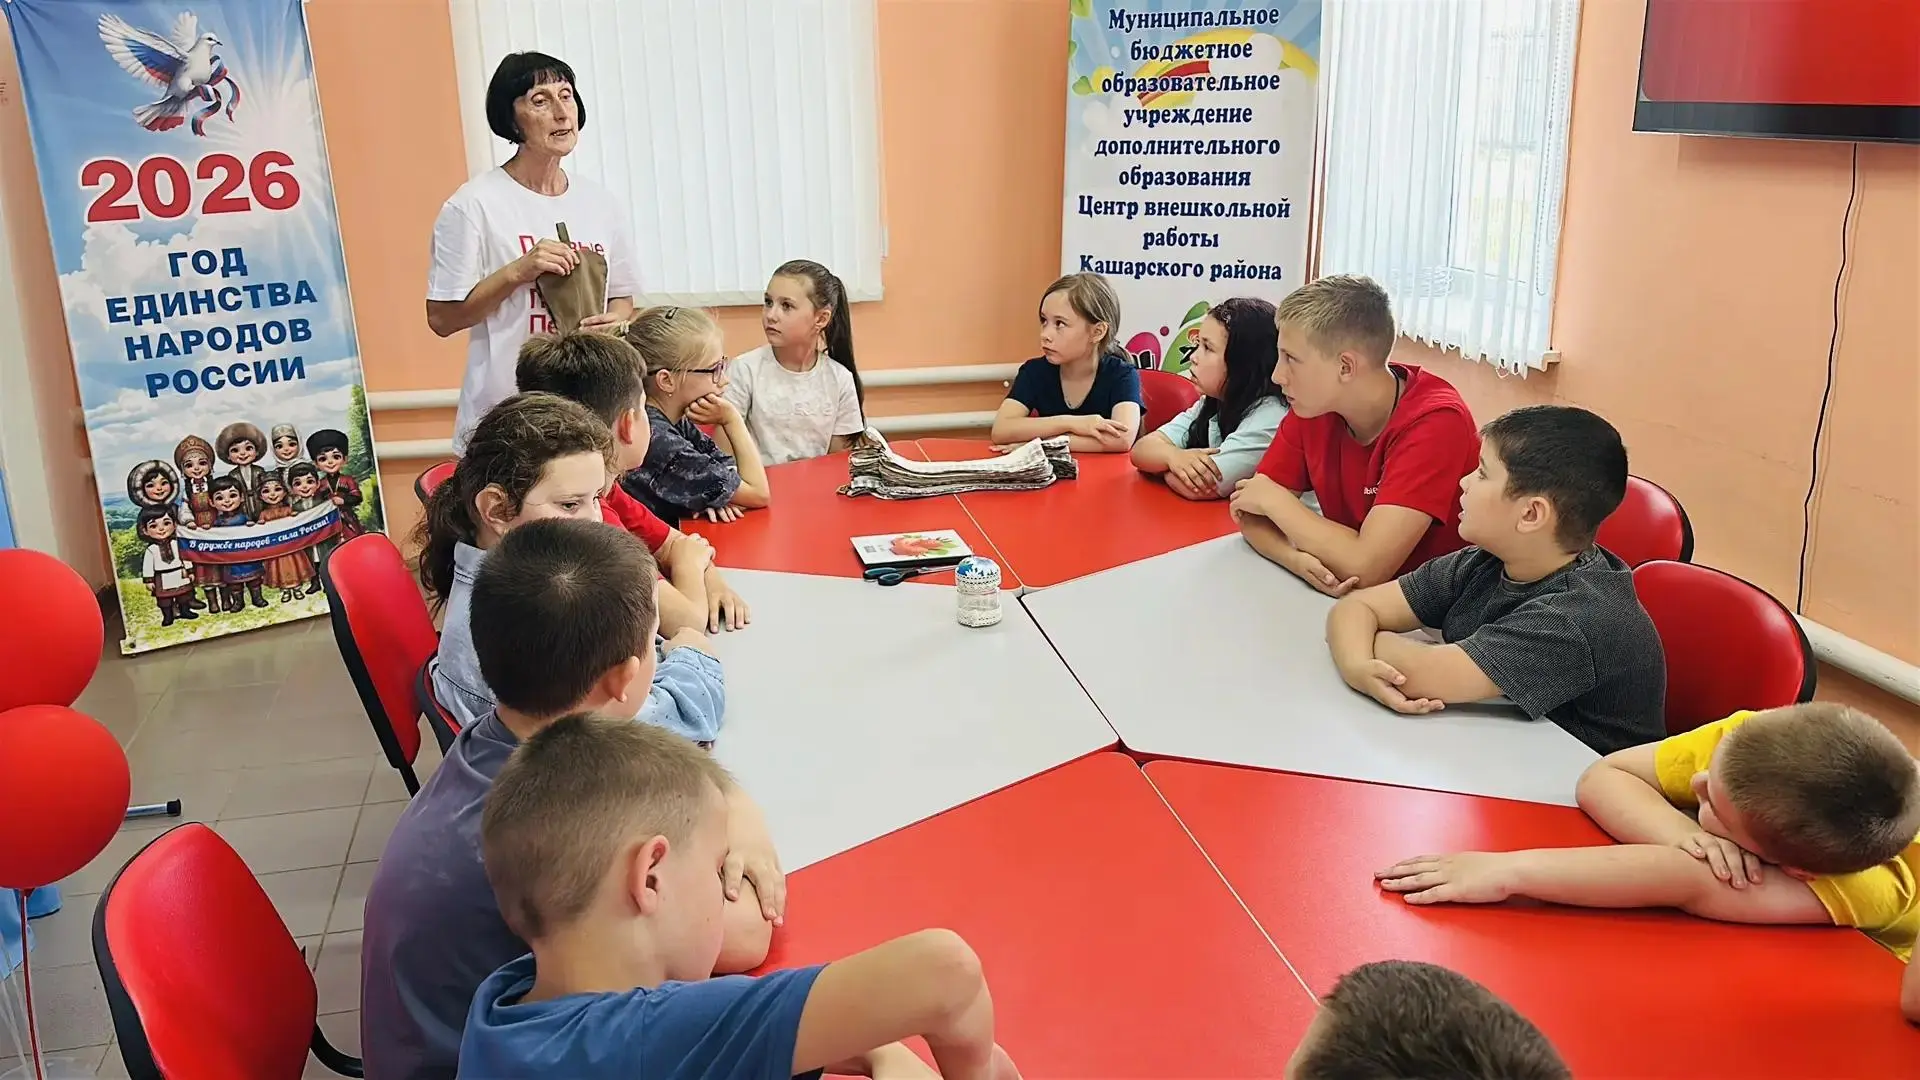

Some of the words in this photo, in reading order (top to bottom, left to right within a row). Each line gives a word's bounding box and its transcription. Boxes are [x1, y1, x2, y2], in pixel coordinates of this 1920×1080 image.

[1109, 9, 1279, 32] Муниципальное
[1131, 40, 1253, 62] бюджетное
[1102, 72, 1280, 96] образовательное
[1124, 107, 1253, 128] учреждение
[1095, 139, 1280, 156] дополнительного
[81, 151, 301, 222] 2026
[1119, 165, 1251, 189] образования
[1079, 195, 1138, 219] Центр
[1144, 198, 1290, 218] внешкольной
[1143, 227, 1219, 249] работы
[168, 247, 248, 278] ГОД
[1080, 255, 1204, 279] Кашарского
[1210, 260, 1282, 281] района
[106, 279, 317, 325] ЕДИНСТВА
[124, 318, 313, 361] НАРОДОВ
[146, 357, 306, 398] РОССИИ
[189, 540, 195, 549] В
[198, 540, 233, 551] дружбе
[234, 536, 270, 550] народов
[278, 531, 299, 542] сила
